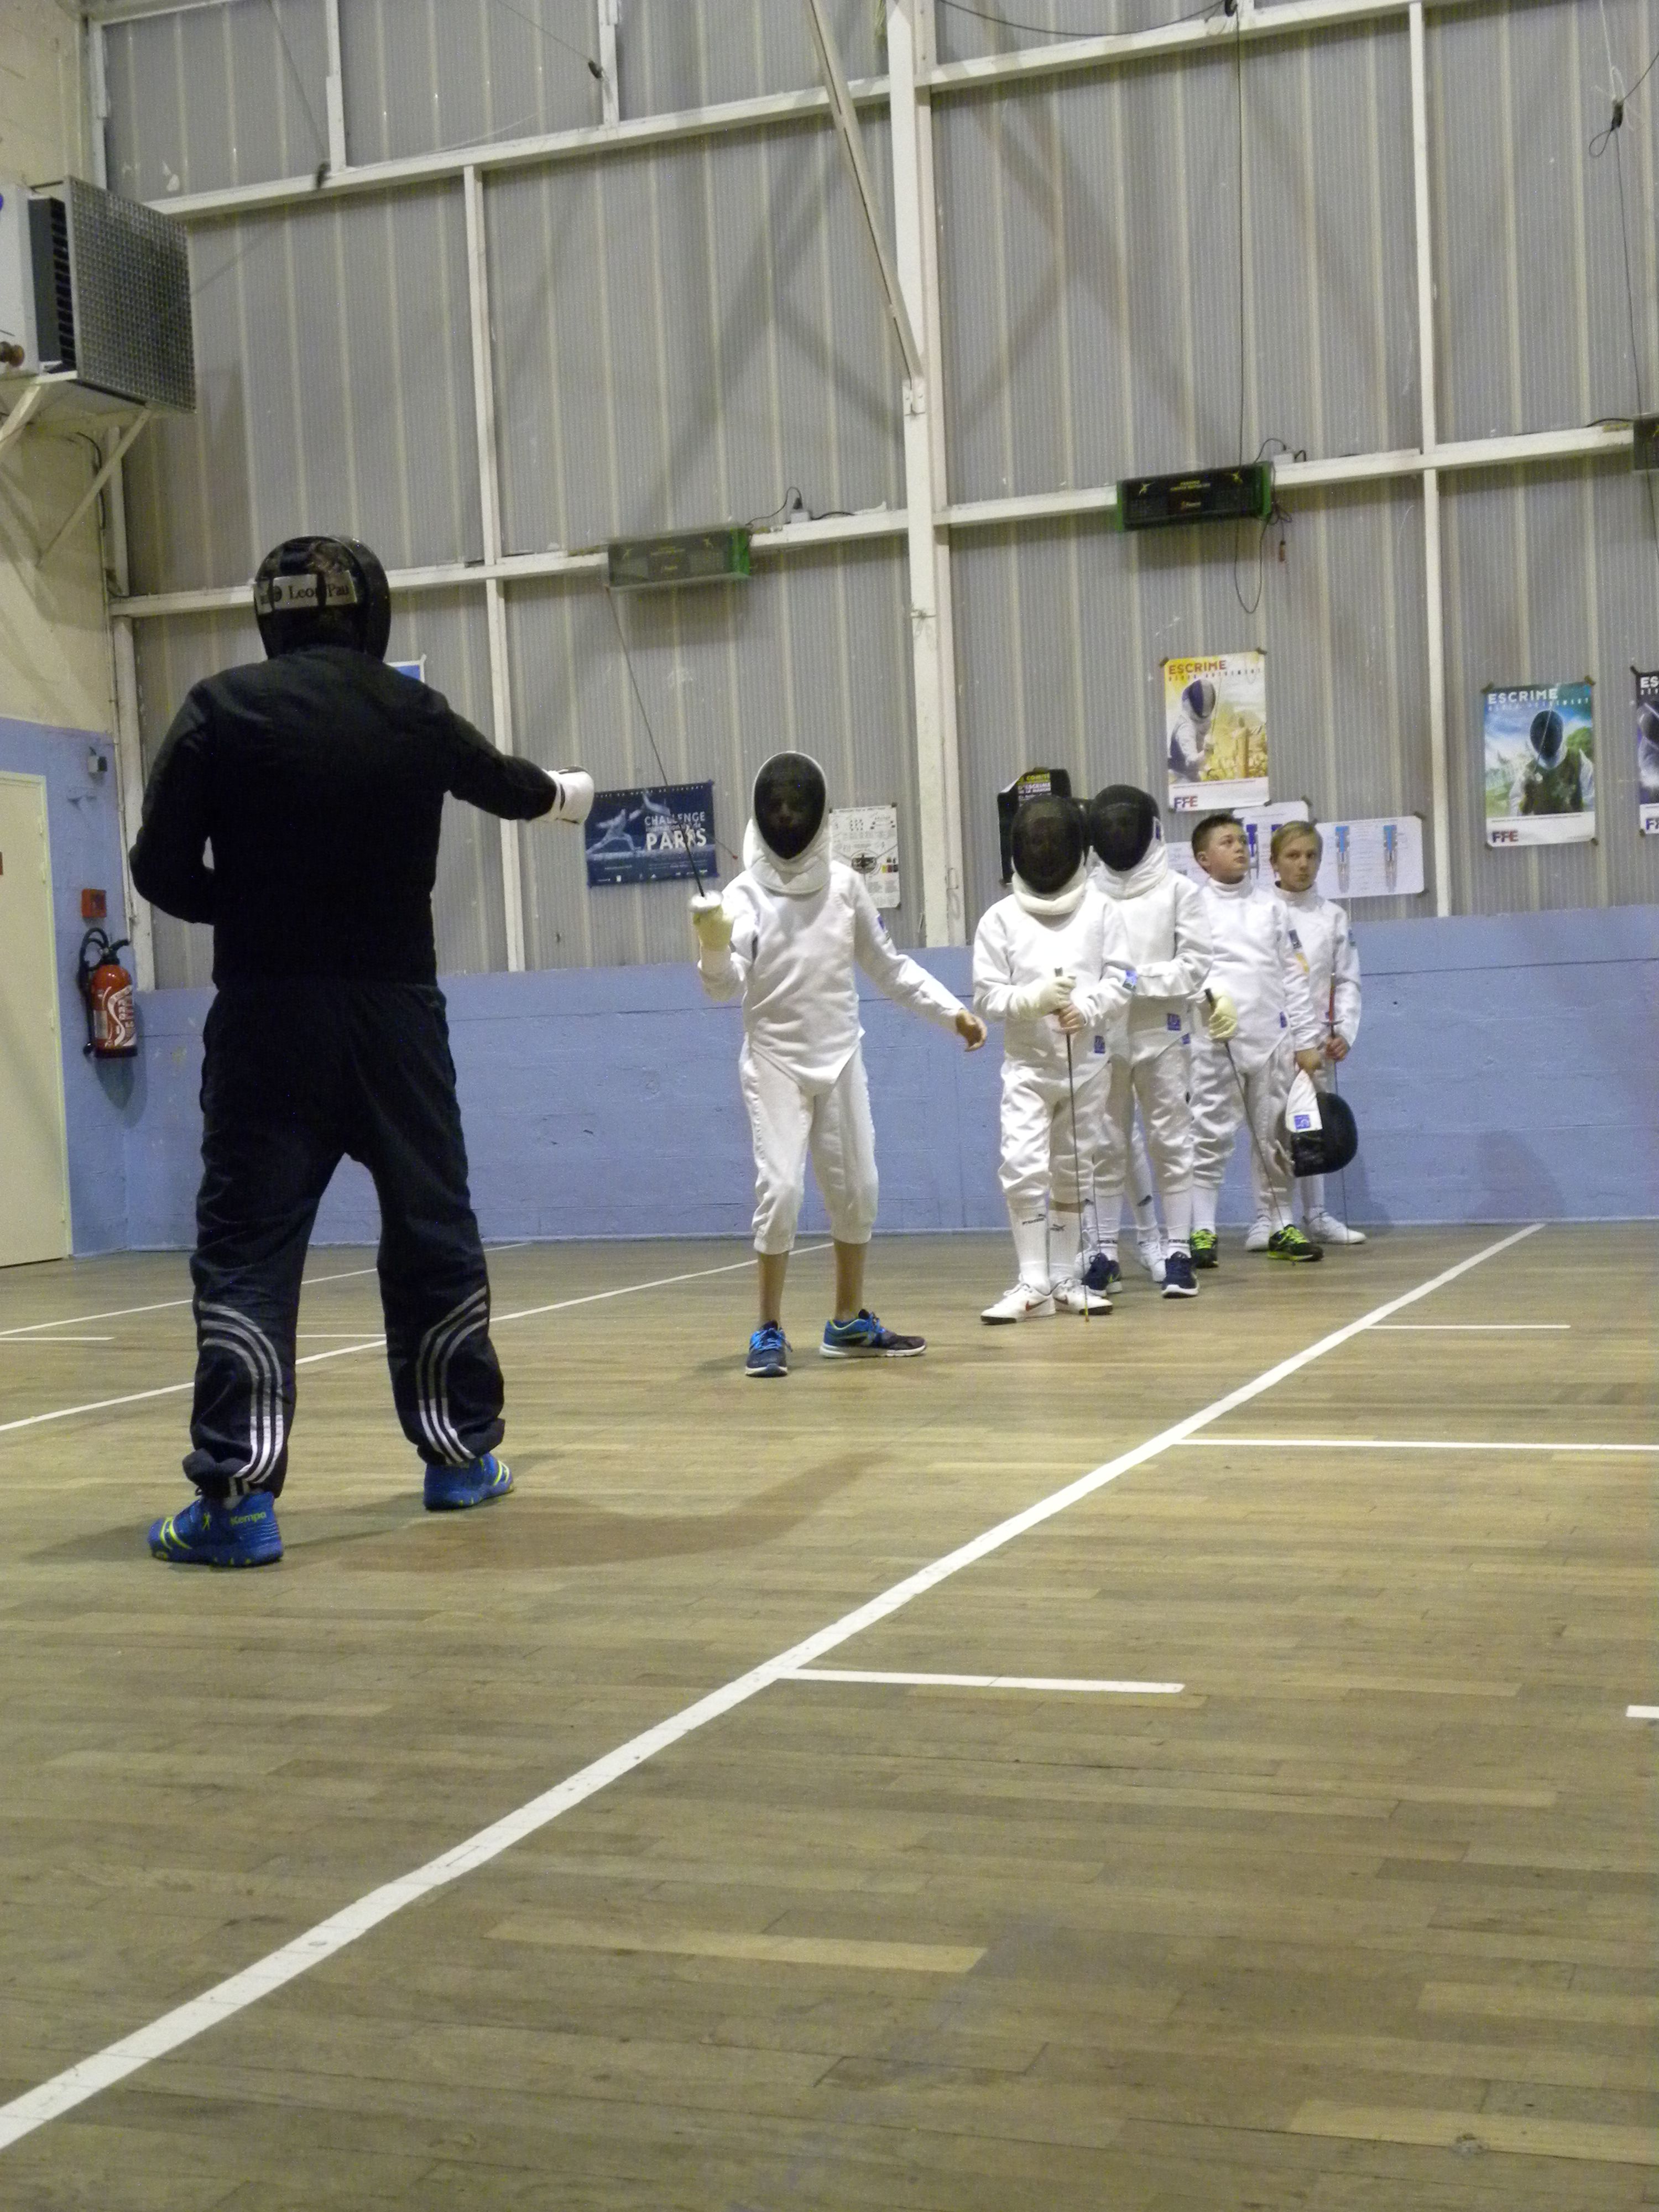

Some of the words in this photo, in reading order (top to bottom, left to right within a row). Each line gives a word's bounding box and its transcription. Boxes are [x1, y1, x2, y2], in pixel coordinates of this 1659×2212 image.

[1168, 660, 1227, 675] ESCRIME
[1488, 688, 1558, 705] ESCRIME
[1174, 796, 1198, 808] FFE
[644, 811, 706, 826] CHALLENGE
[1493, 830, 1519, 843] FFE
